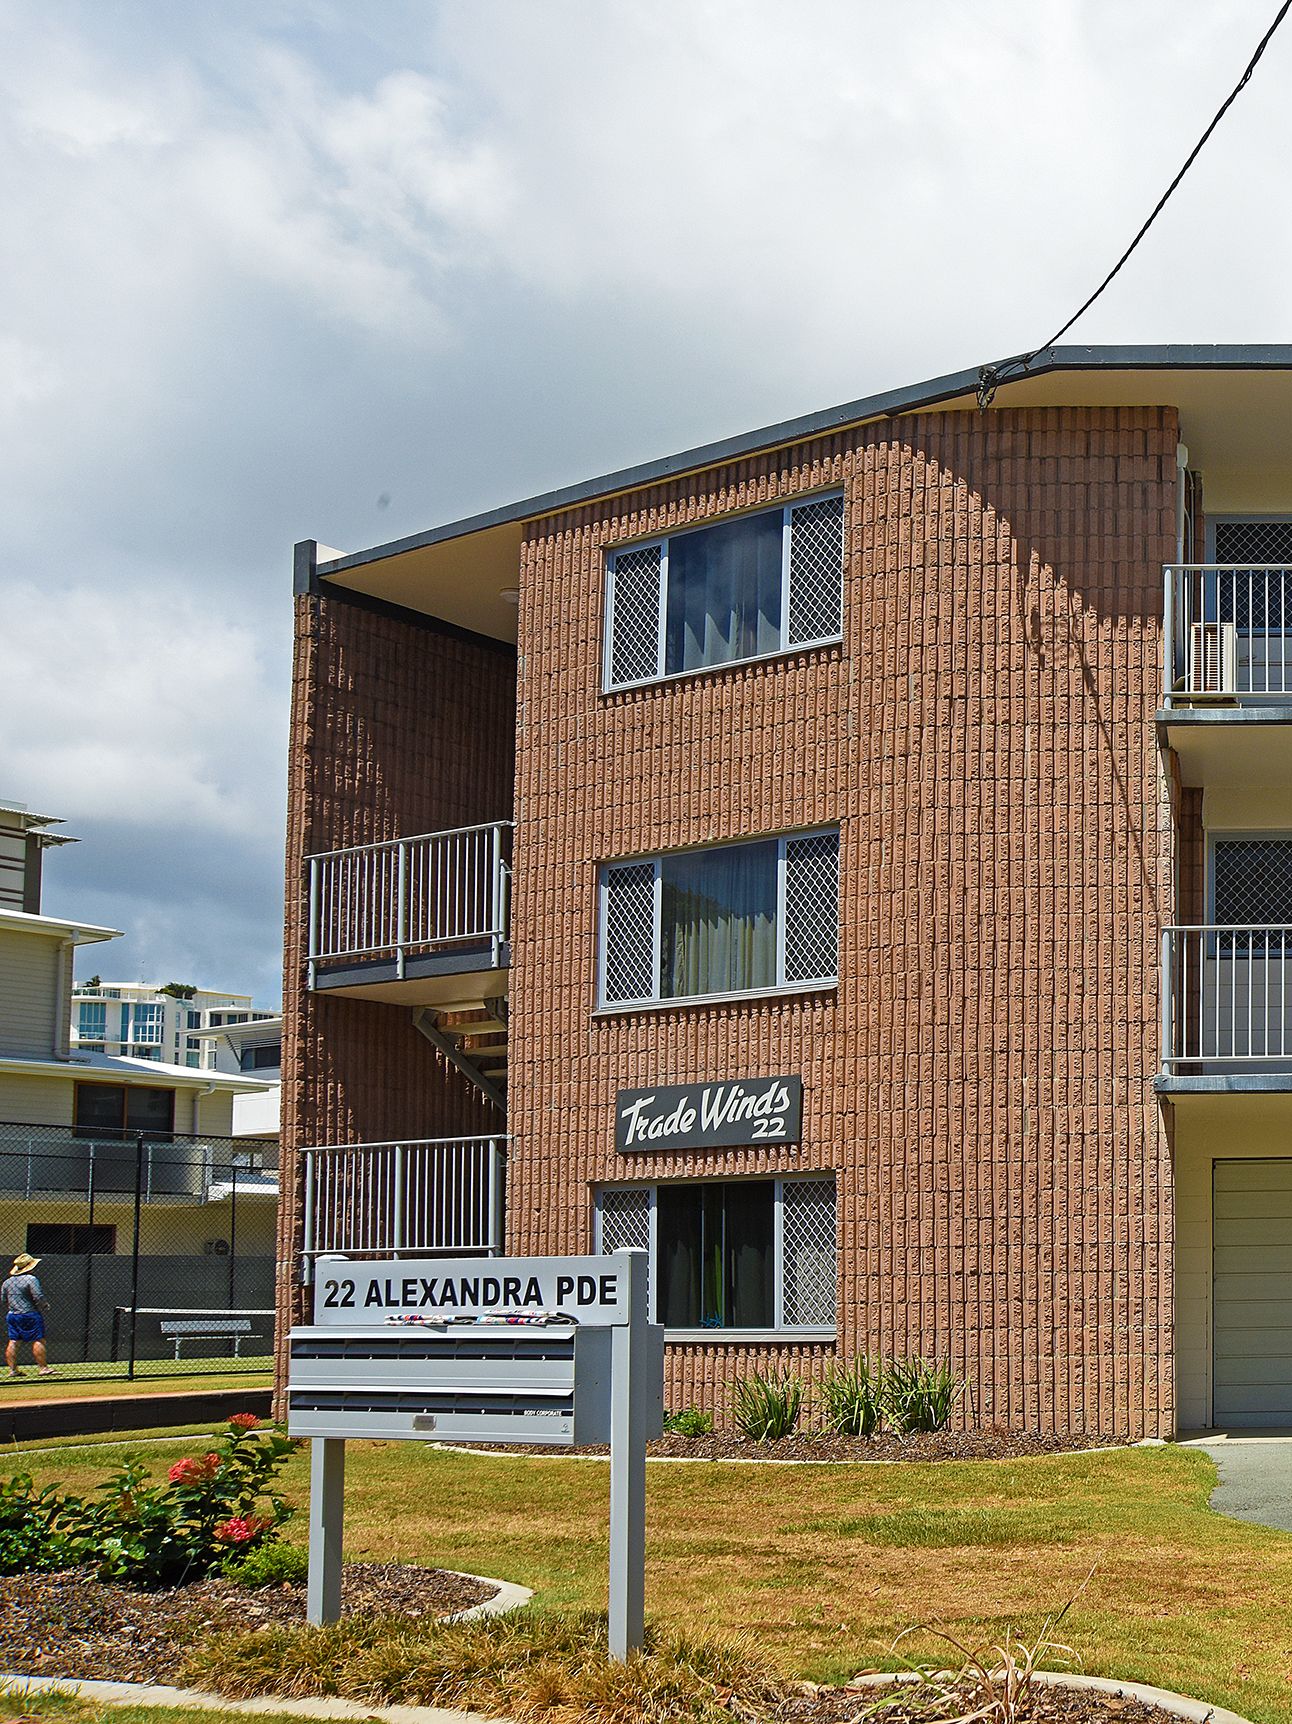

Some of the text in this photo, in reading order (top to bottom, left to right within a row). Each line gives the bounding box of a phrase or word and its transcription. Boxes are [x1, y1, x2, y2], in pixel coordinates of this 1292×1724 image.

[621, 1080, 791, 1146] Trade Winds
[751, 1117, 787, 1139] 22
[323, 1275, 618, 1308] 22 ALEXANDRA PDE
